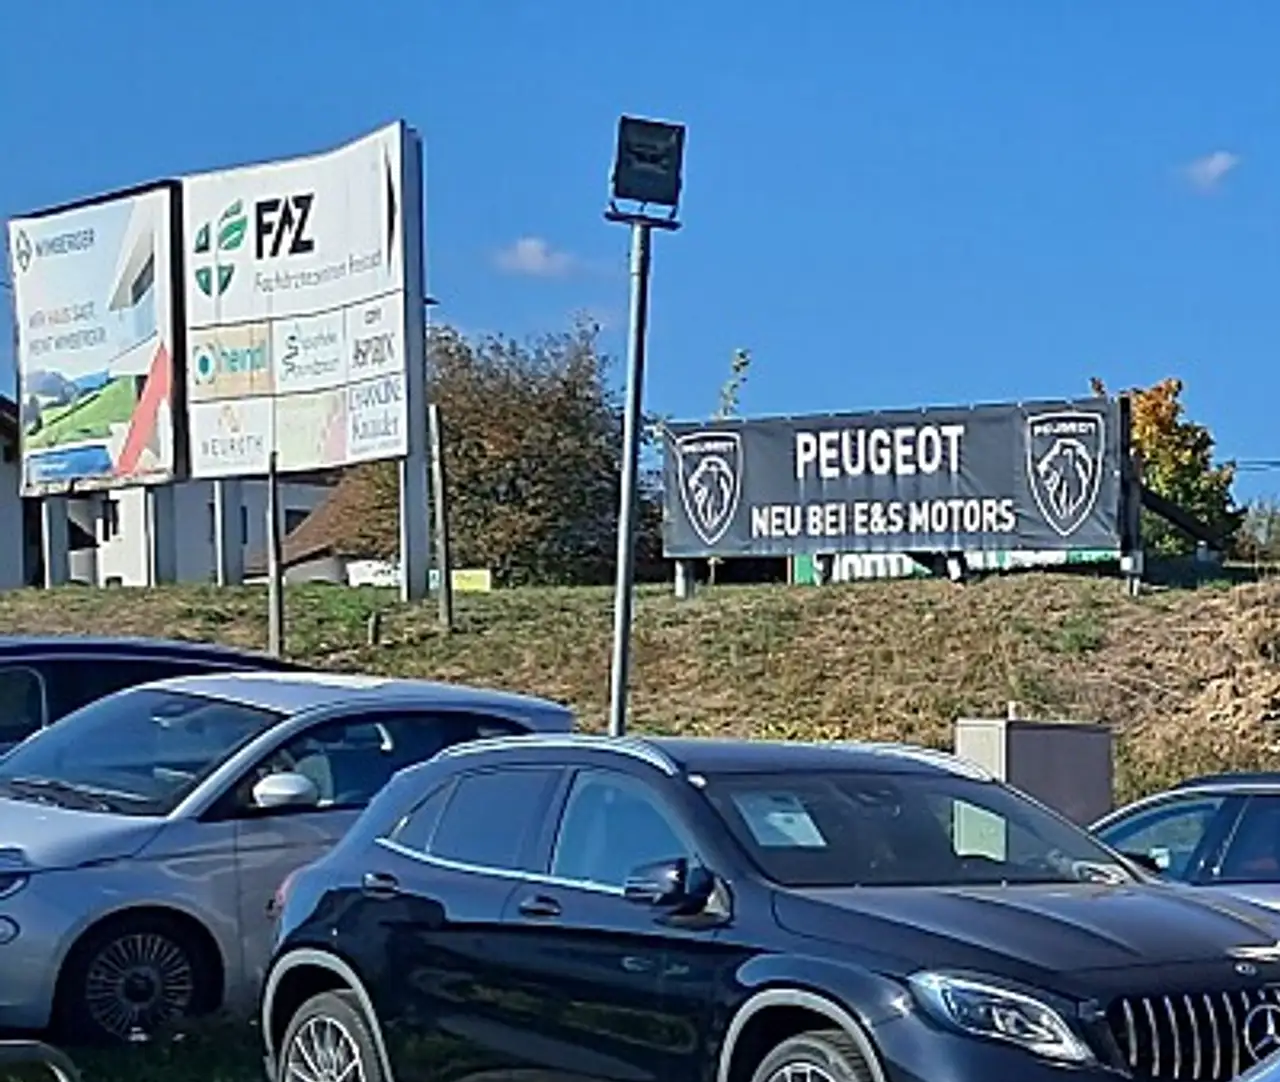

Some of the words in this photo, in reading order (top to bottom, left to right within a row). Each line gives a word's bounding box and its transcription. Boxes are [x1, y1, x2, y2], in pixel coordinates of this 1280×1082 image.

[256, 193, 314, 260] FAZ
[796, 424, 965, 478] PEUGEOT
[751, 505, 802, 539] NEU
[807, 503, 846, 536] BEI
[853, 501, 902, 535] E&S
[909, 498, 1017, 534] MOTORS
